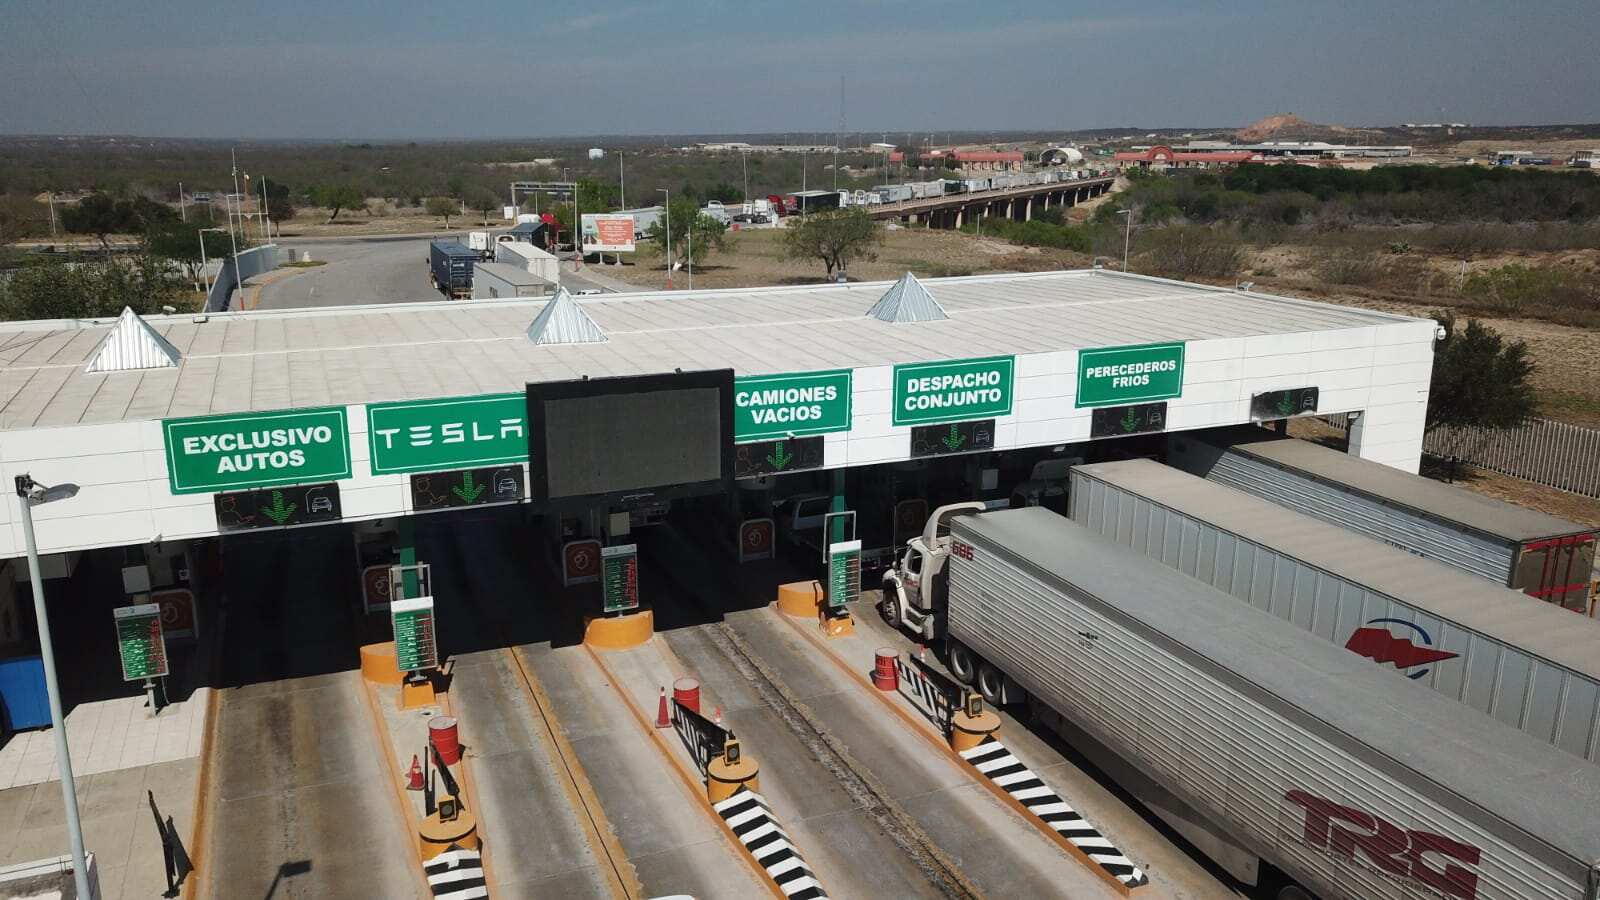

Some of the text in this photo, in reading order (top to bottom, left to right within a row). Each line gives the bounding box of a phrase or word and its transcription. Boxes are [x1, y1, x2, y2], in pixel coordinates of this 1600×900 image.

[1086, 359, 1176, 379] PERECEDEROS
[907, 371, 1001, 394] DESPACHO
[1112, 374, 1150, 388] FRIOS
[735, 385, 837, 408] CAMIONES
[904, 388, 1002, 412] CONJUNTO
[751, 404, 822, 425] VACIOS
[183, 426, 332, 456] EXCLUSIVO
[376, 418, 523, 449] TESLA
[217, 449, 306, 475] AUTOS
[1285, 789, 1481, 900] TRG
